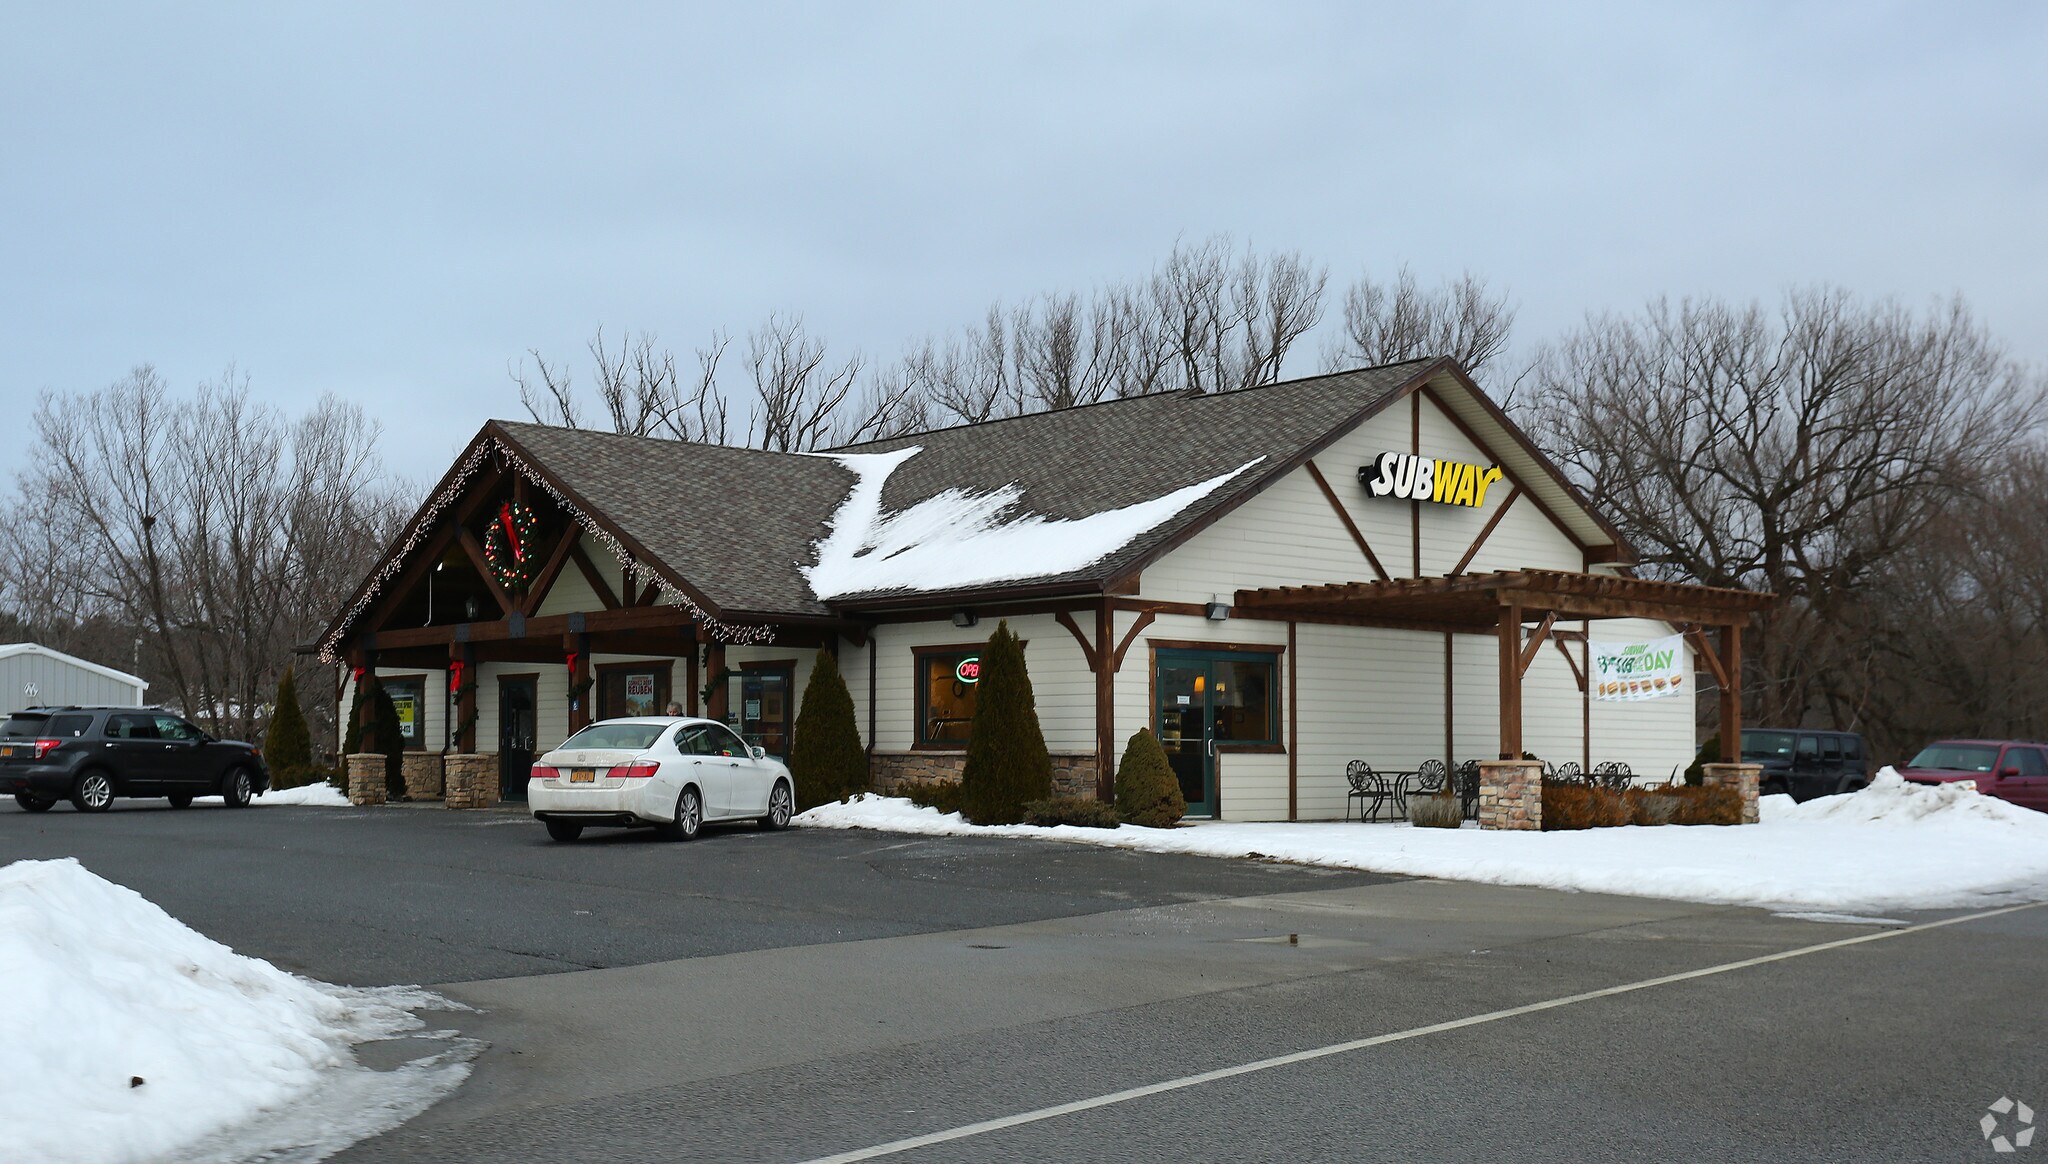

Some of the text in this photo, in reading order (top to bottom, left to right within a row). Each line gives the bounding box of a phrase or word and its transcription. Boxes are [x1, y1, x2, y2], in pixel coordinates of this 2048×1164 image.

[1370, 451, 1504, 508] SUBWAY
[1621, 644, 1649, 656] SUBWAY
[1644, 649, 1674, 672] DAY
[960, 663, 979, 677] OPE
